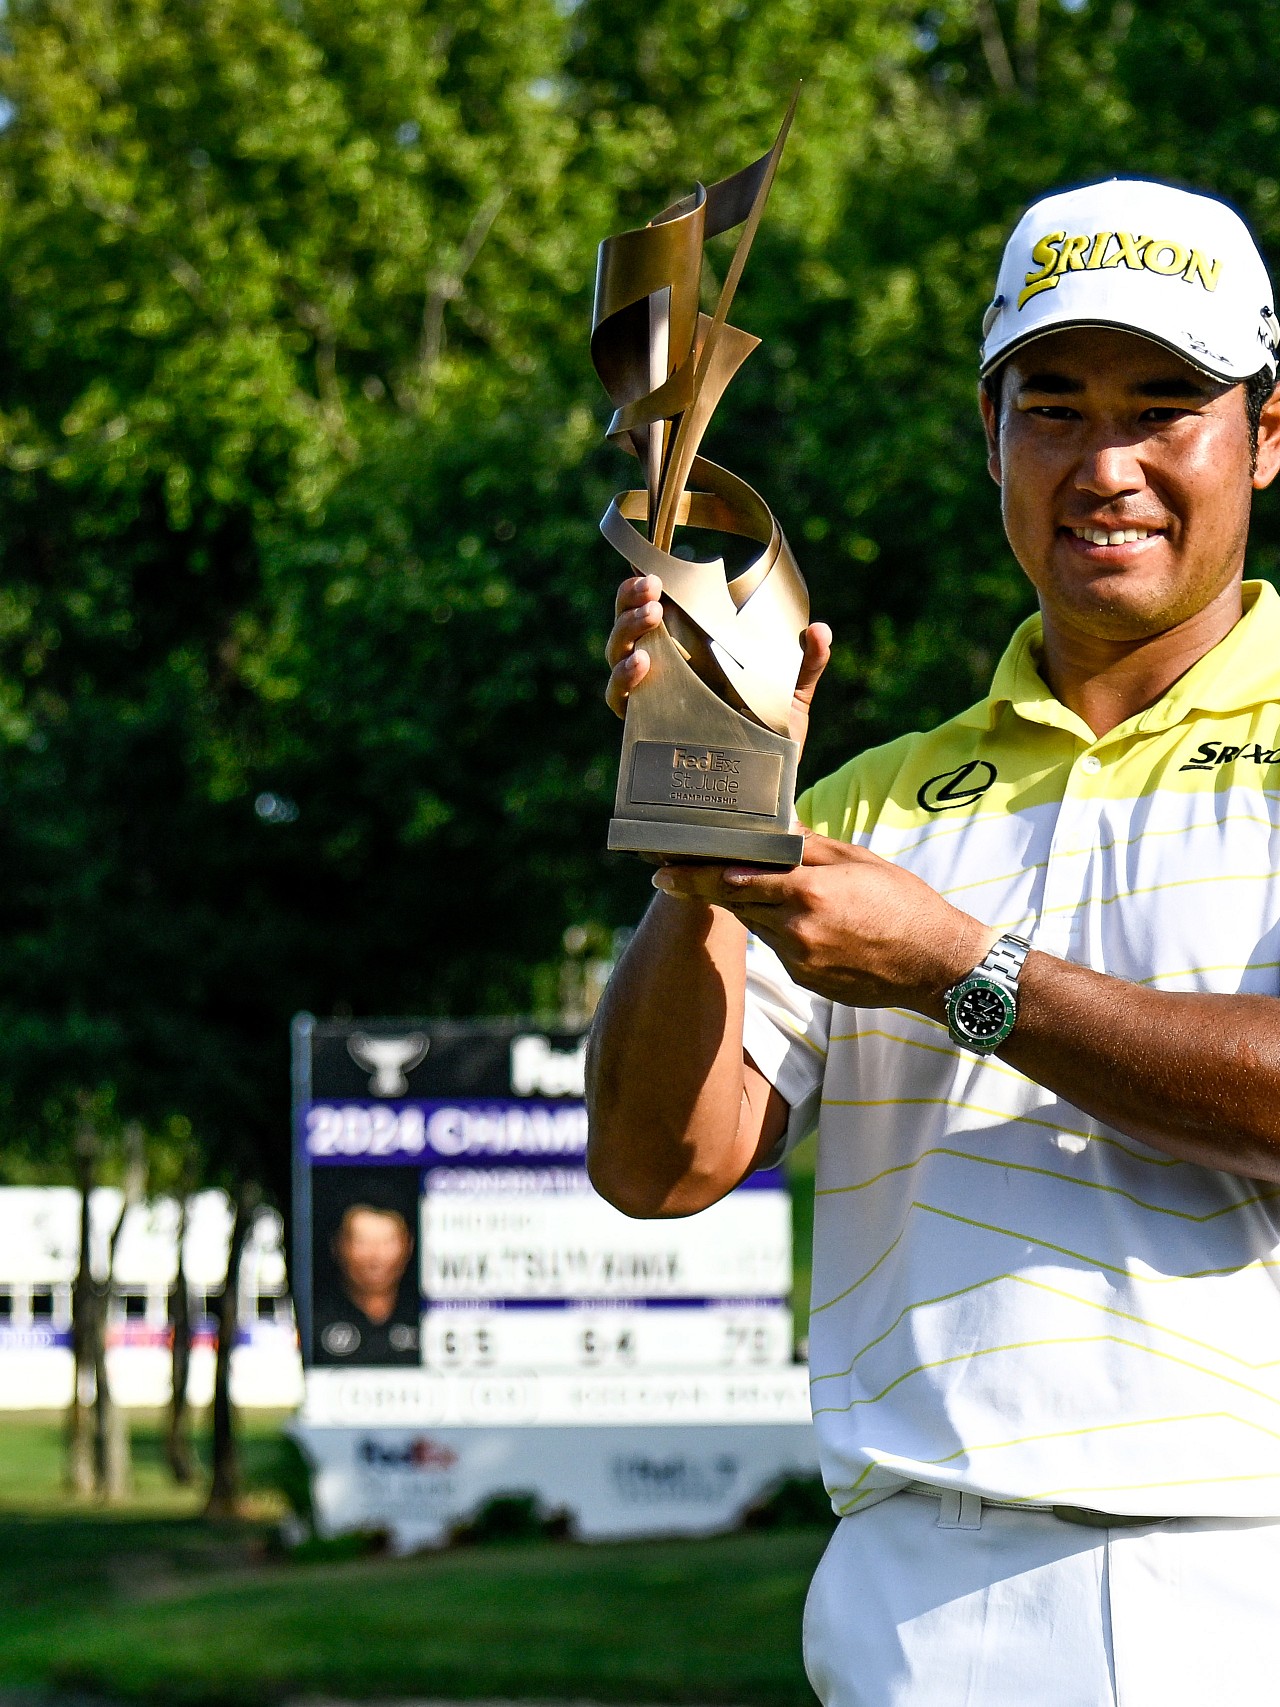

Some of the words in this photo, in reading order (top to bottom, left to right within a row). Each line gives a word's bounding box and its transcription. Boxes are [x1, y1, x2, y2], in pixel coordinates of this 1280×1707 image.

[1019, 231, 1223, 311] SRIXON
[673, 748, 740, 773] FedEx
[670, 792, 737, 805] CHAMPIONSHIP
[306, 1105, 425, 1155] 2024
